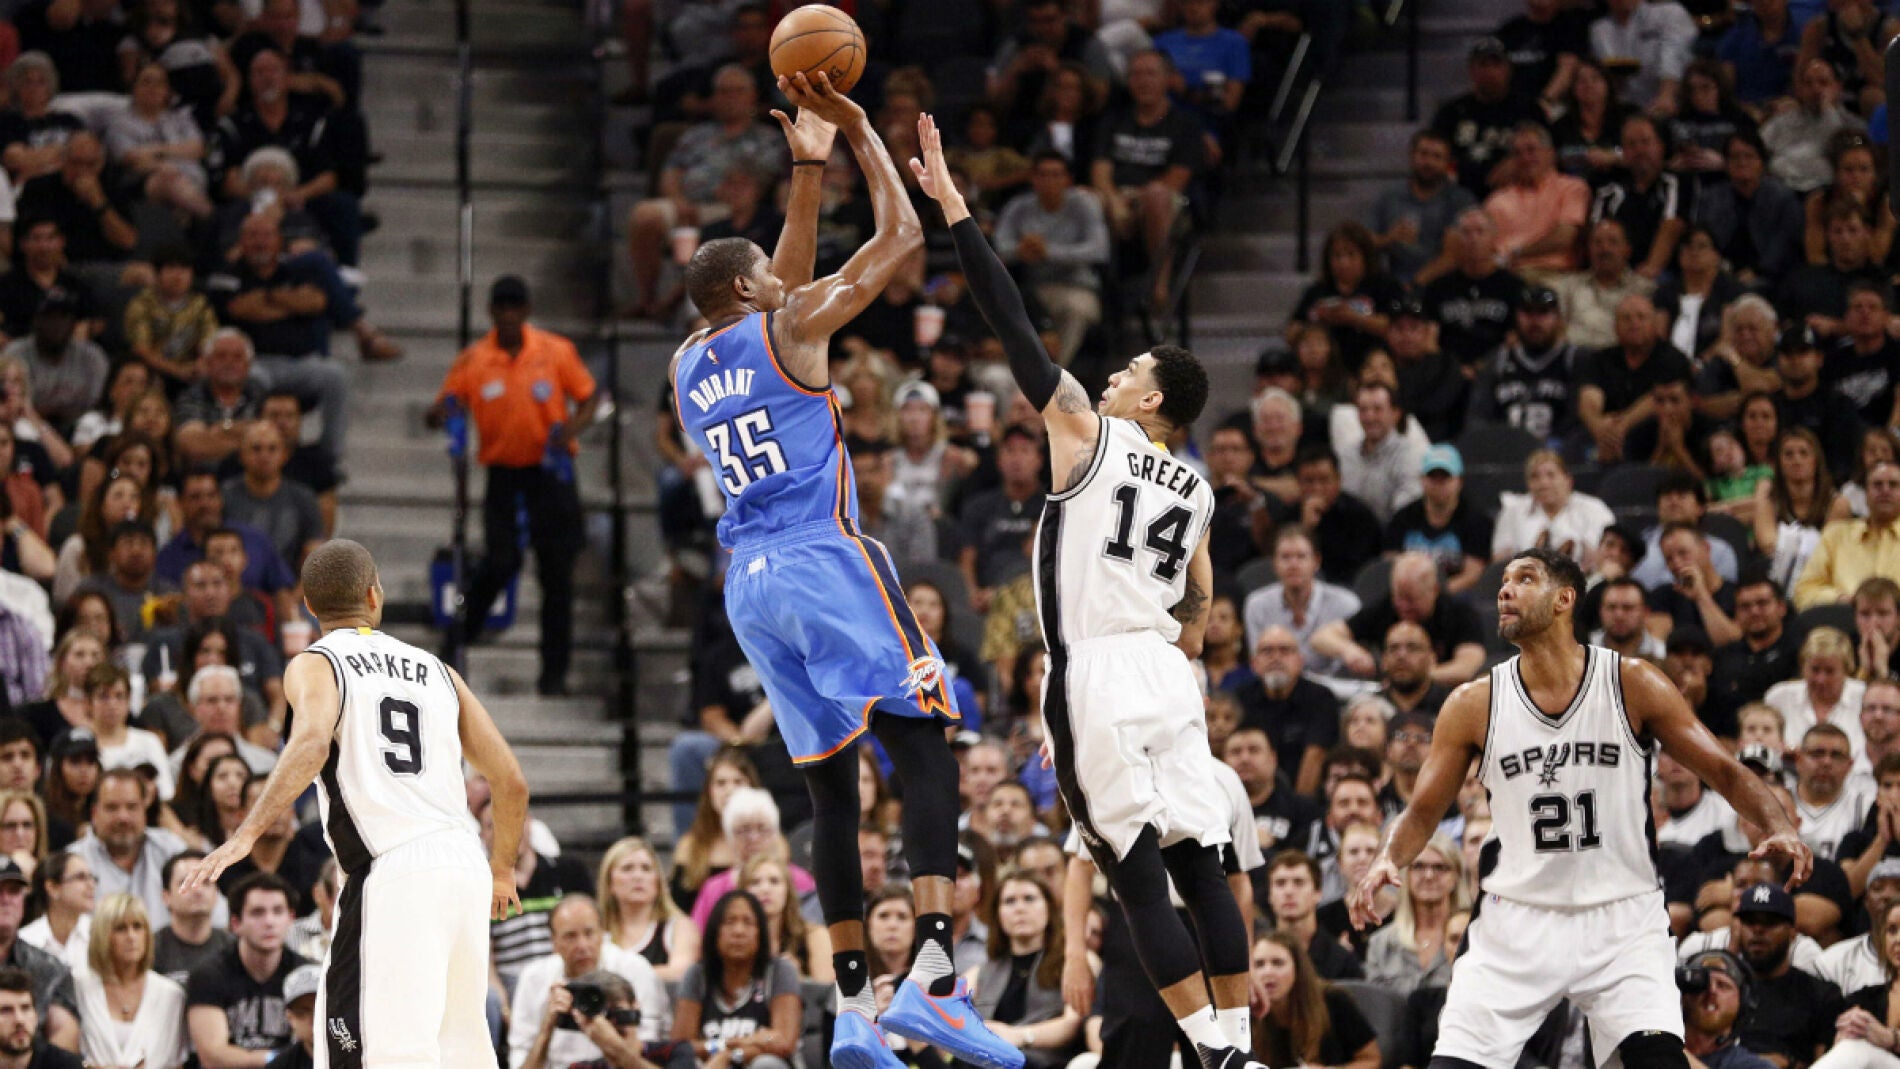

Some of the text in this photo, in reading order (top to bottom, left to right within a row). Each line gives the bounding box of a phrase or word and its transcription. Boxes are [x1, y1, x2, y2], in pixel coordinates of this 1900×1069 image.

[689, 368, 756, 413] DURANT
[703, 406, 790, 497] 35
[1127, 452, 1200, 500] GREEN
[1102, 481, 1198, 585] 14
[345, 652, 428, 686] PARKER
[377, 692, 426, 778] 9
[1499, 742, 1621, 788] SPURS
[1528, 789, 1601, 854] 21
